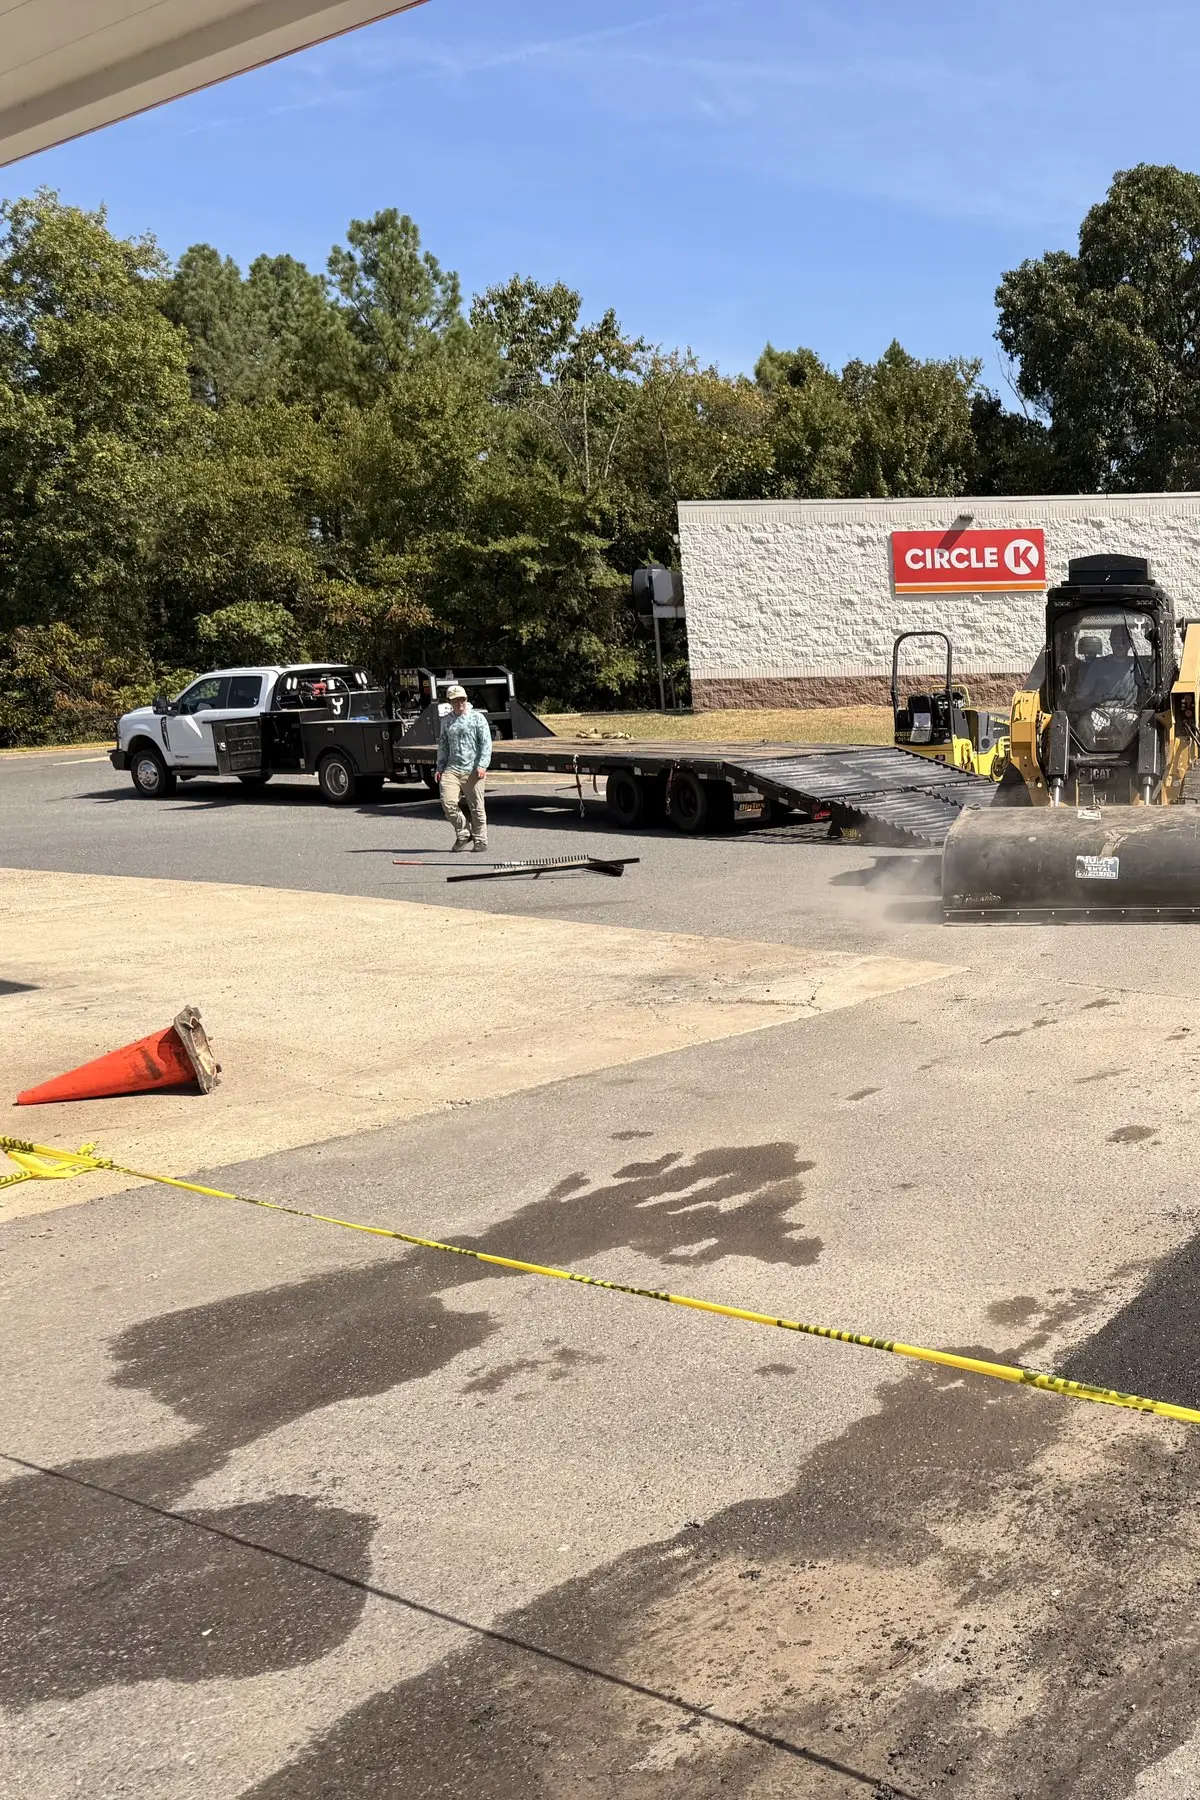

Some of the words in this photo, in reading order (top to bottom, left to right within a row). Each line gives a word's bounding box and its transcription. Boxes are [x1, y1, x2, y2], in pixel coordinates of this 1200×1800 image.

[905, 547, 999, 569] CIRCLE
[1012, 544, 1038, 573] K
[1092, 768, 1111, 779] CAT
